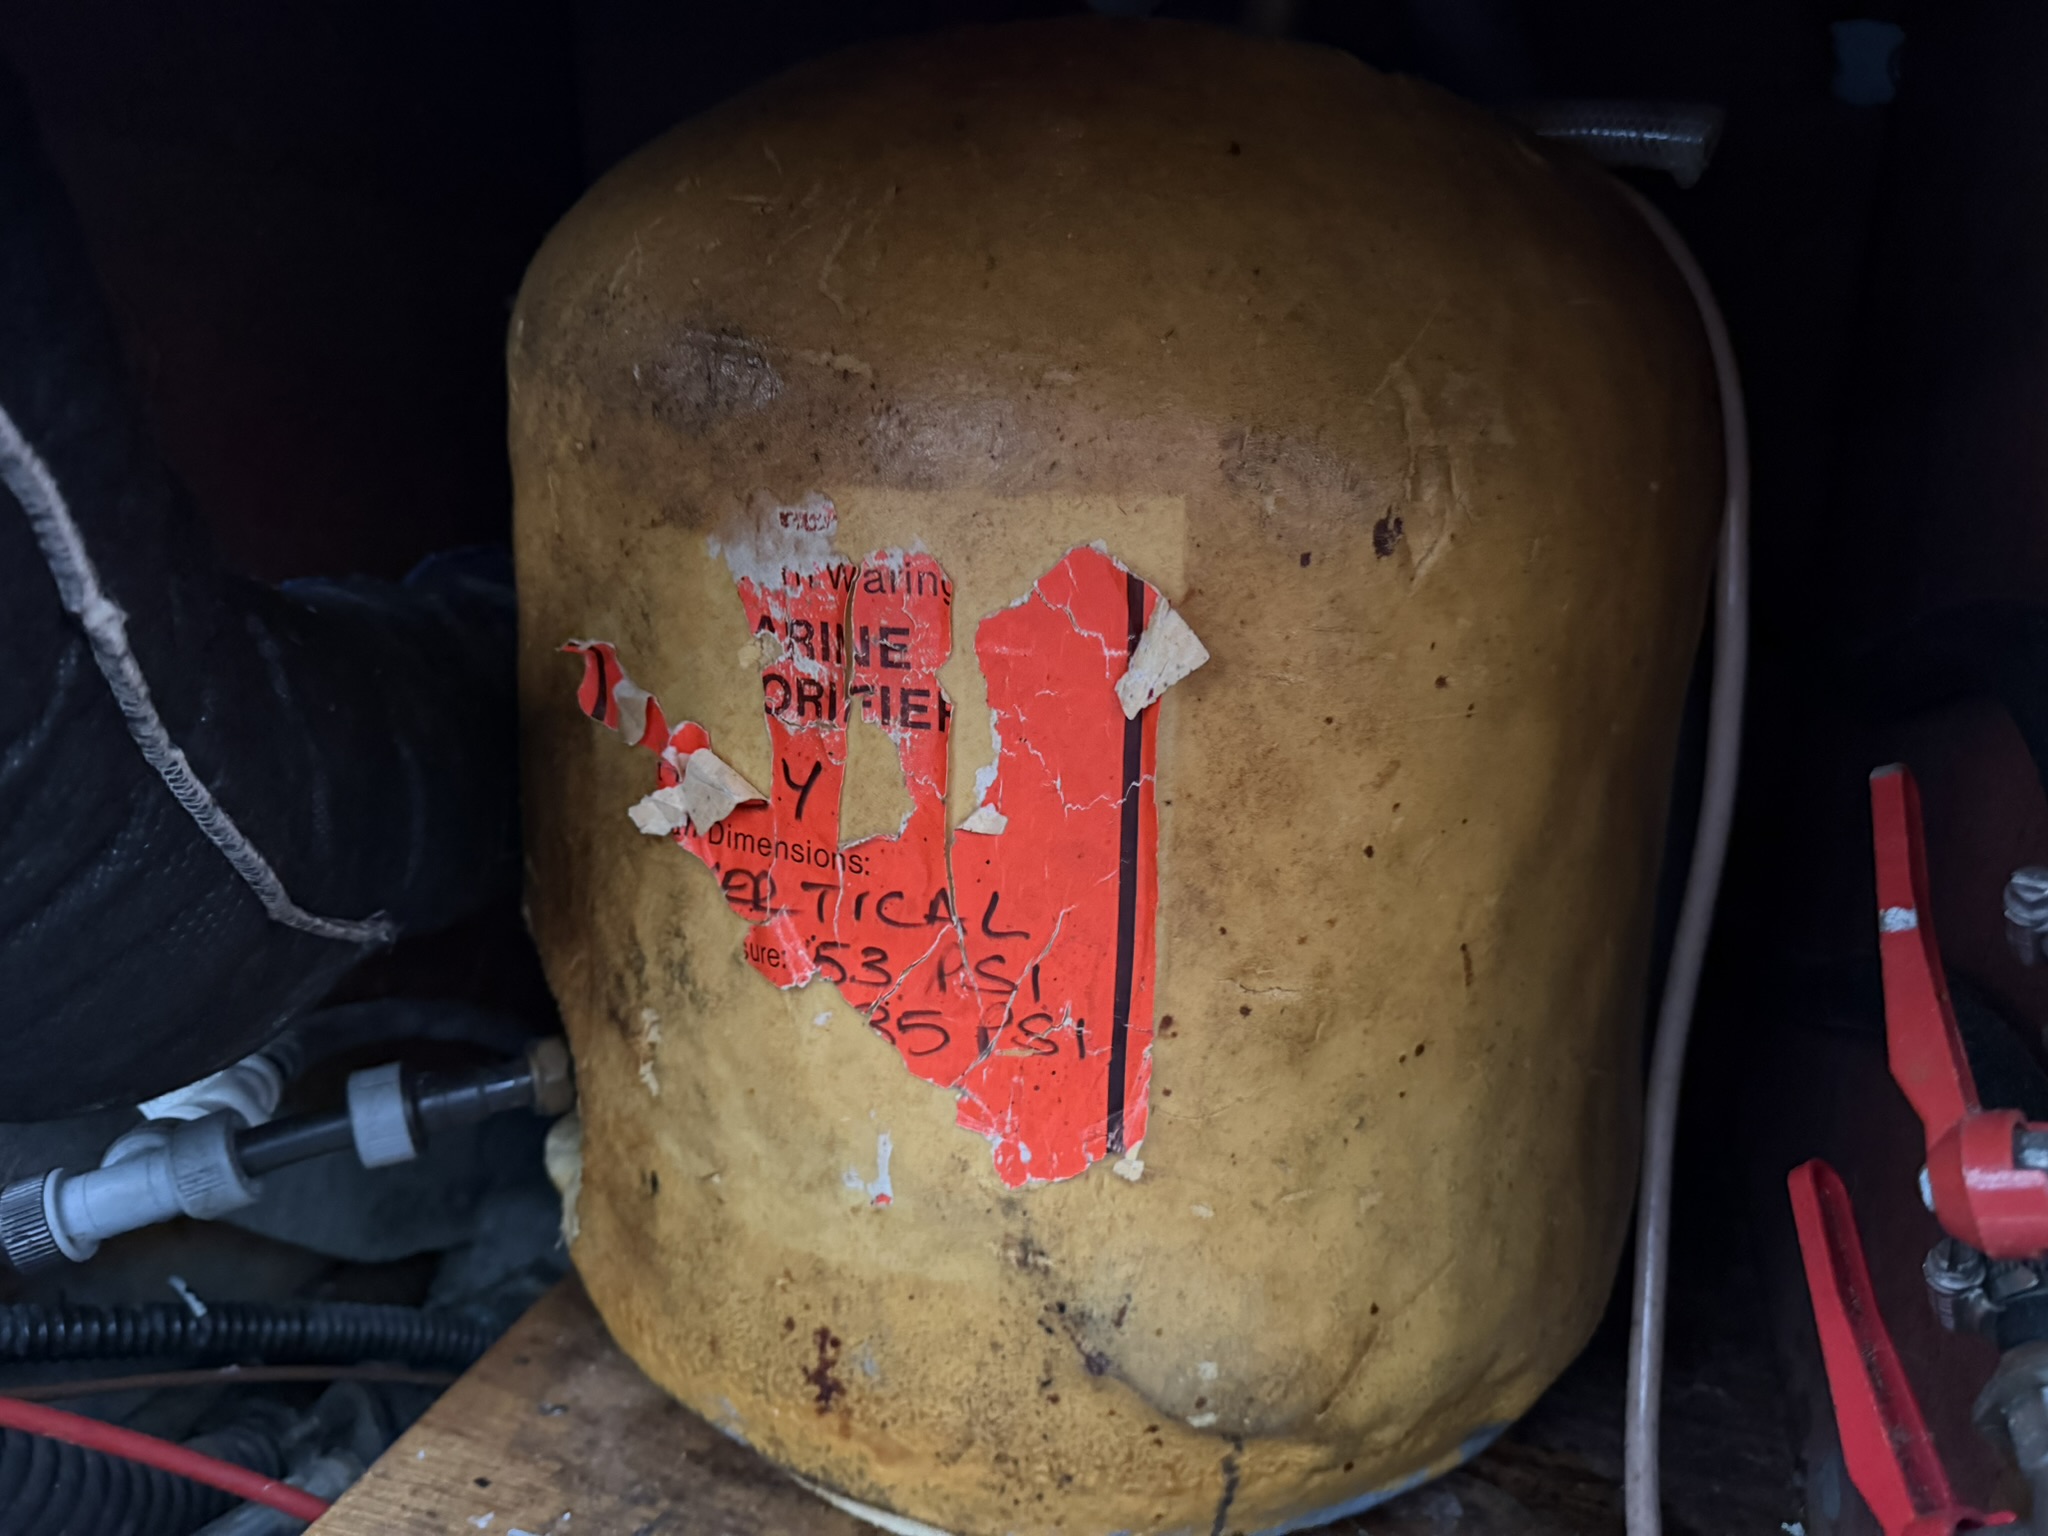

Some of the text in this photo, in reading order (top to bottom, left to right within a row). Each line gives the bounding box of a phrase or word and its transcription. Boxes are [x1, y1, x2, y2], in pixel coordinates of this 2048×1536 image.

[708, 820, 870, 876] Dimensions:
[712, 861, 1031, 940] ERTICAL
[935, 942, 1040, 1003] PSI
[976, 1001, 1086, 1060] PSI
